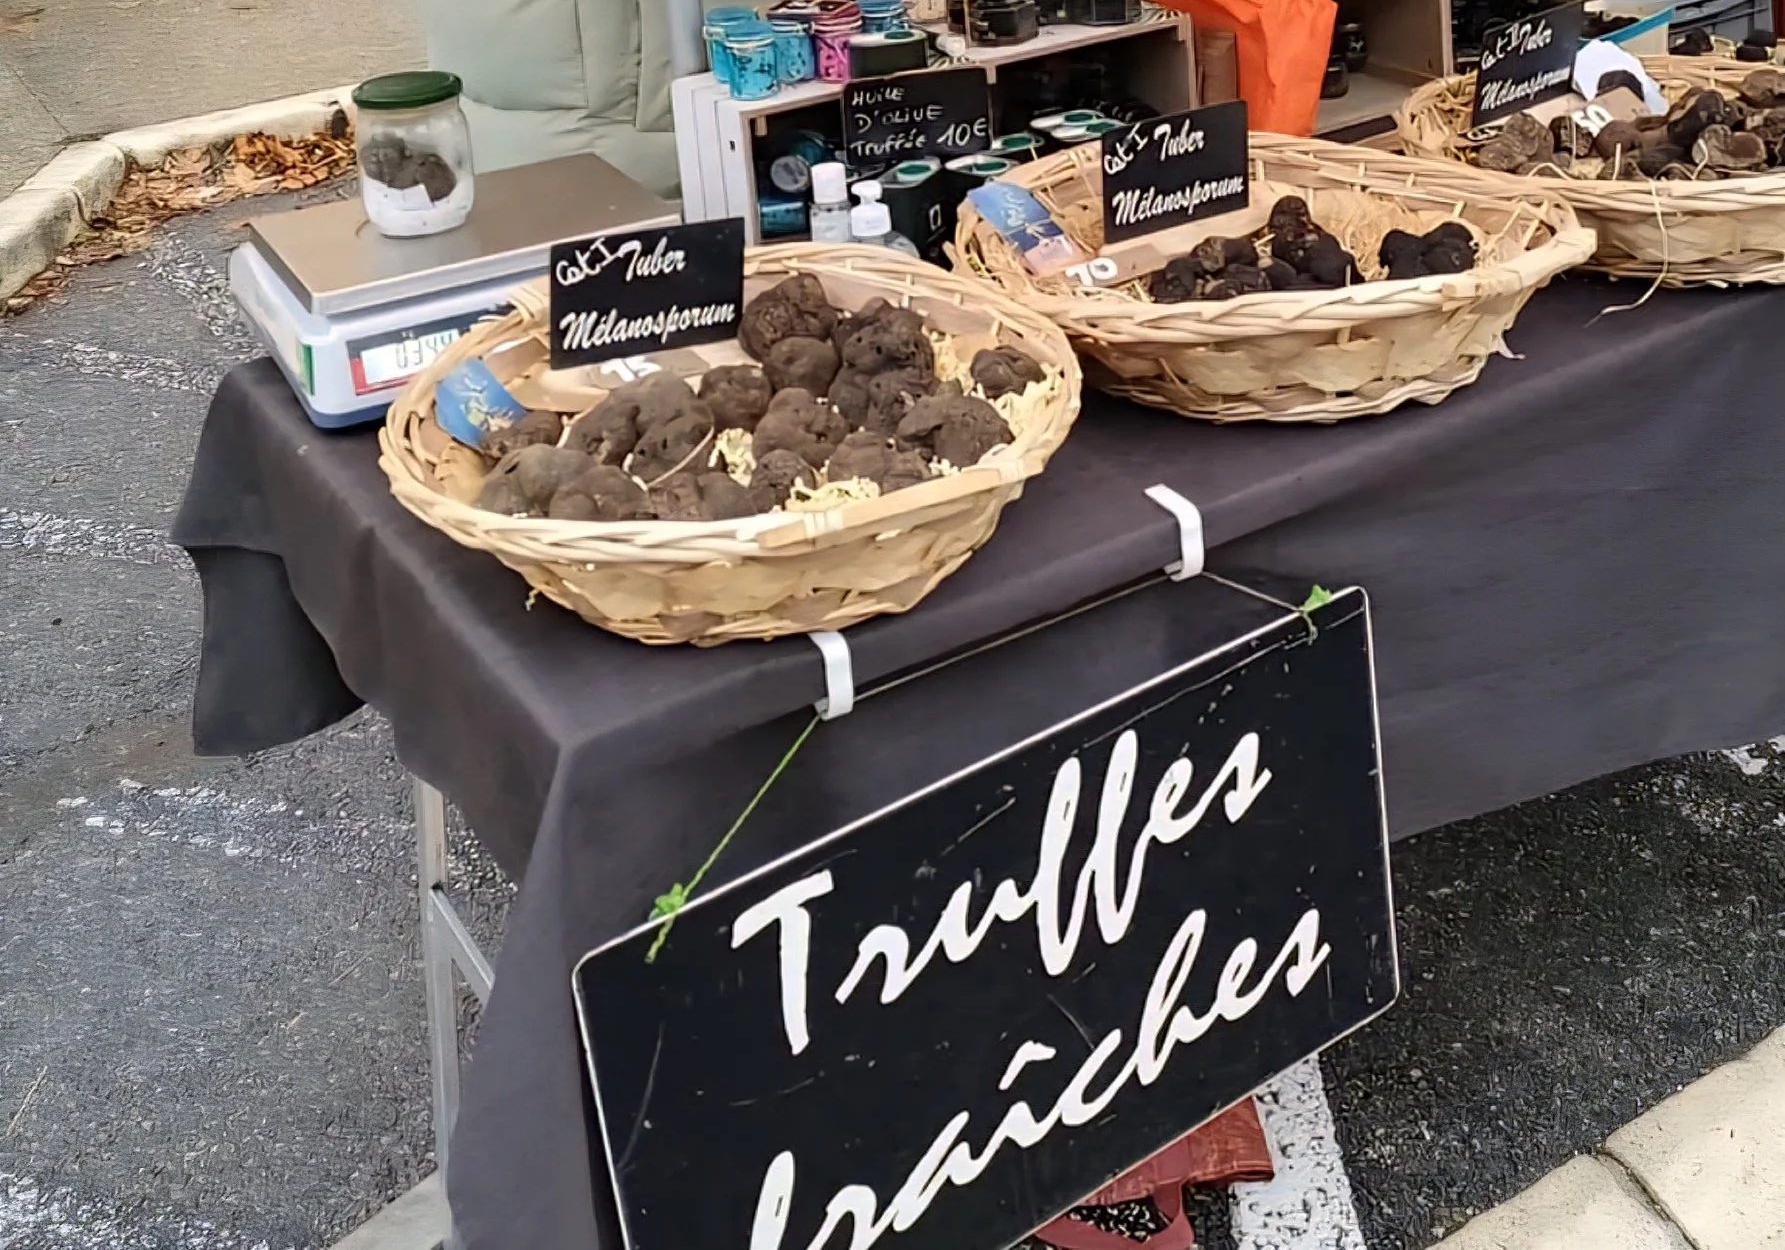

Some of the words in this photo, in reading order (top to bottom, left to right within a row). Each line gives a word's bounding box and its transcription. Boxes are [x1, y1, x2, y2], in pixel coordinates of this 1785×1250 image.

[1153, 118, 1205, 162] Tuber
[1111, 175, 1245, 227] Mélanosporum
[618, 236, 688, 282] Tuber
[558, 303, 736, 350] Mélanosporum
[731, 729, 1273, 1056] Truffes
